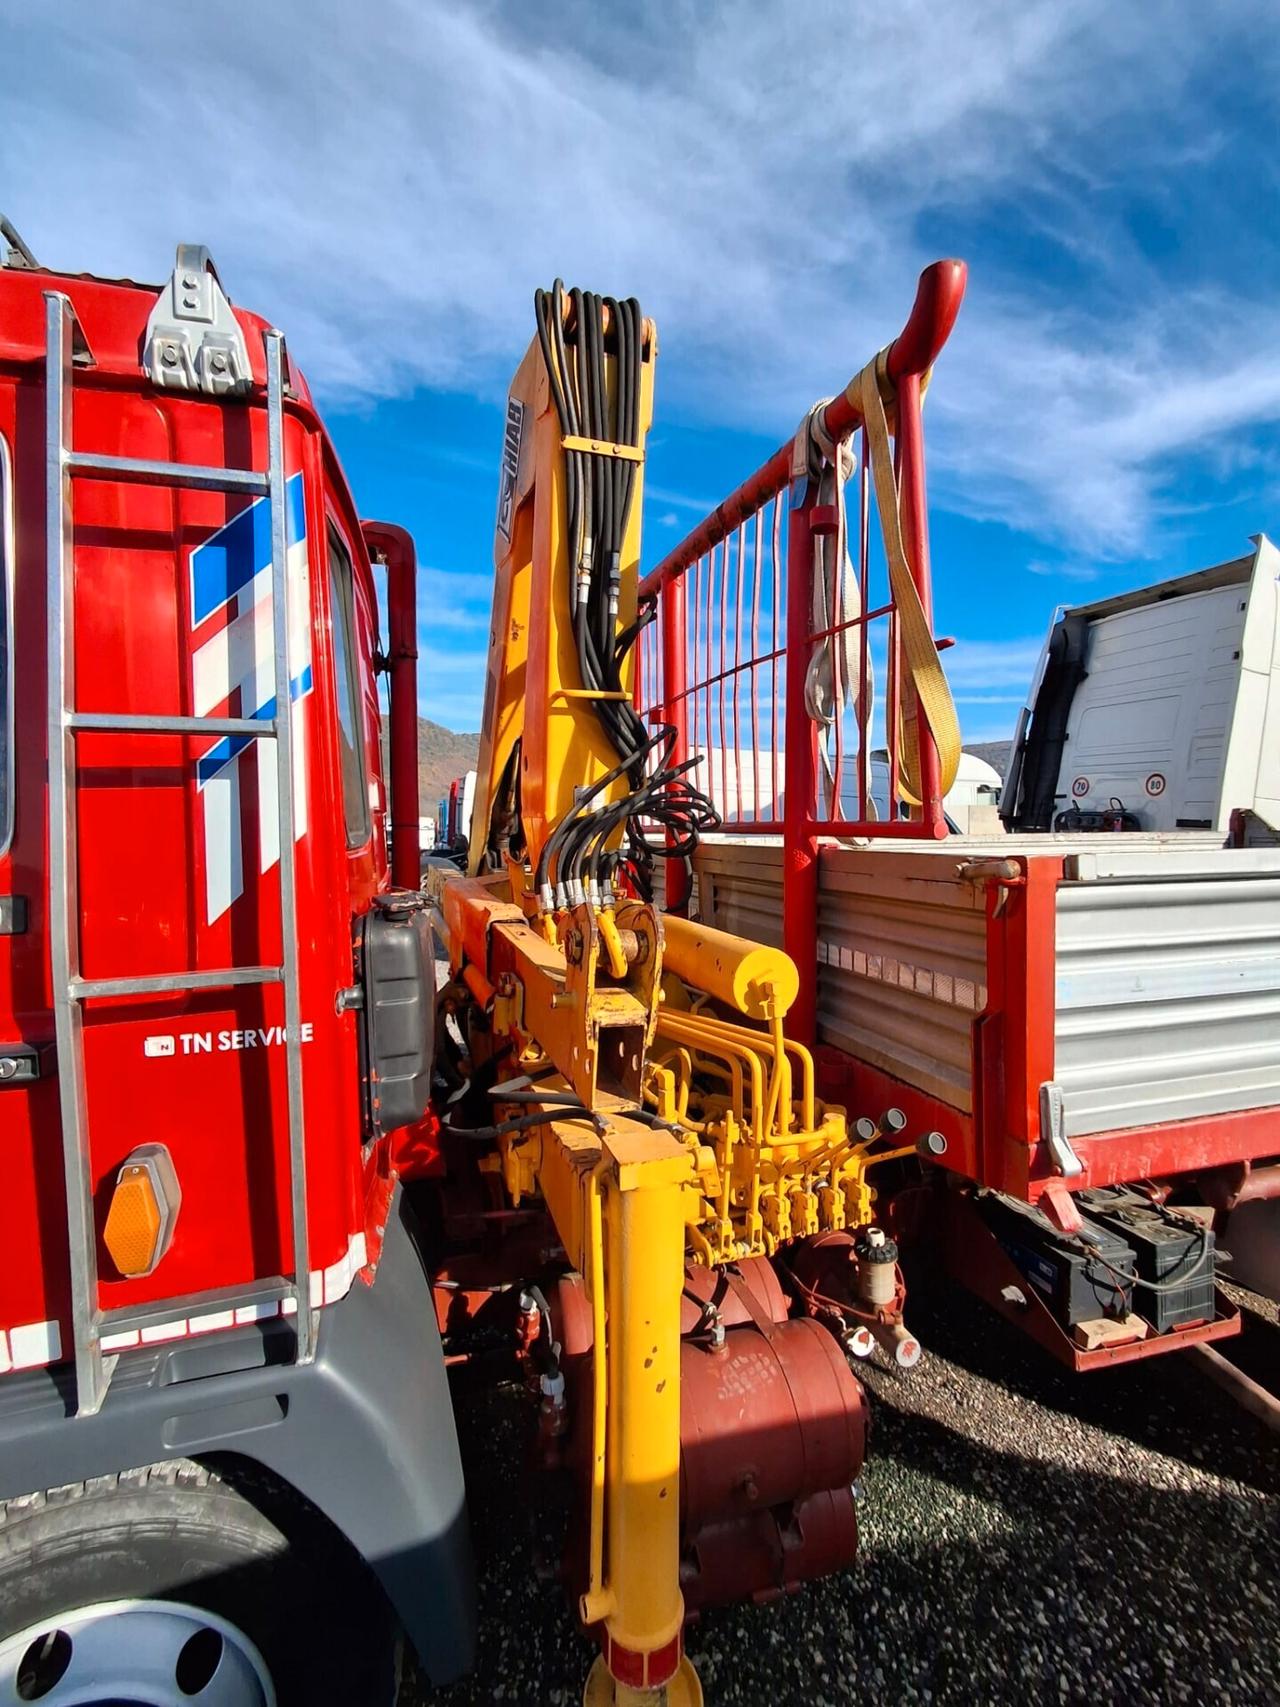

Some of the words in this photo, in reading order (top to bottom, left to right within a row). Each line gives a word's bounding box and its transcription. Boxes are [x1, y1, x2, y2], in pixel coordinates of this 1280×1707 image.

[503, 402, 522, 478] HIAB
[1077, 782, 1086, 791] 70
[1150, 780, 1160, 790] 80
[180, 1032, 212, 1054] TN
[218, 1023, 313, 1050] SERVIE
